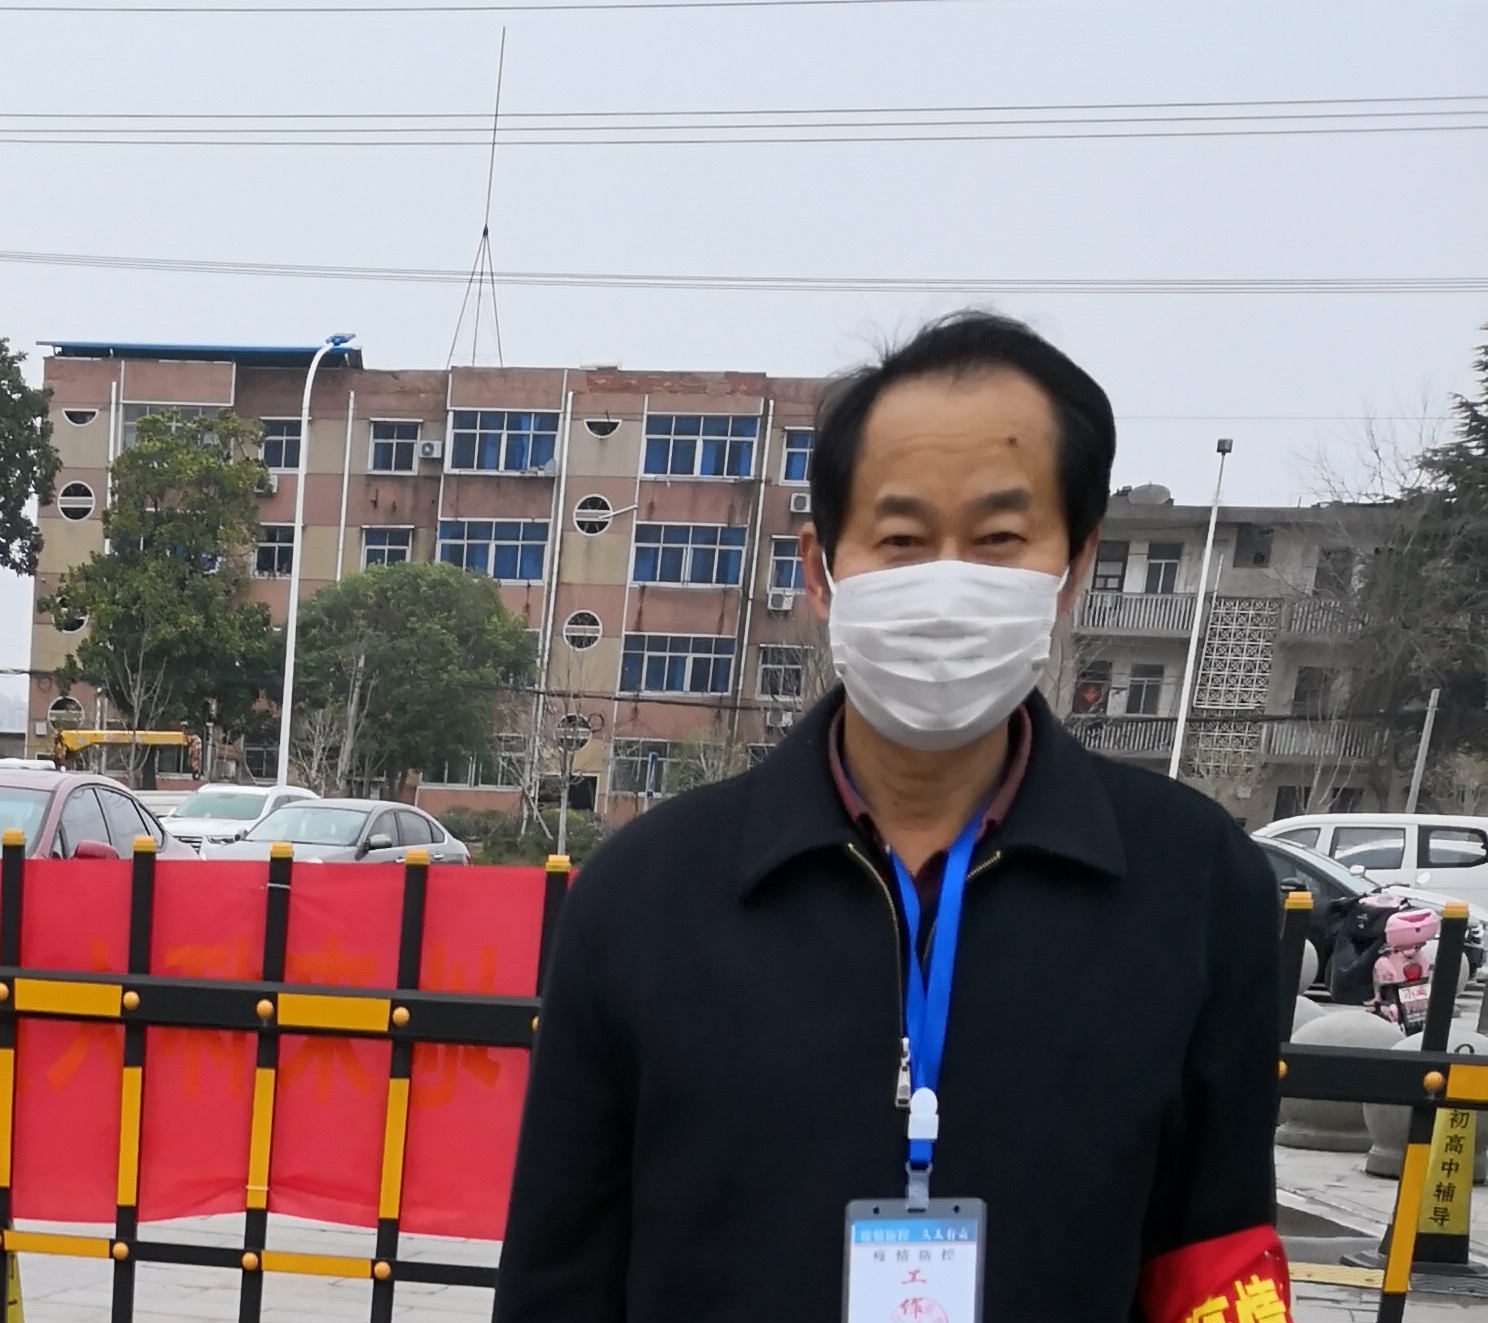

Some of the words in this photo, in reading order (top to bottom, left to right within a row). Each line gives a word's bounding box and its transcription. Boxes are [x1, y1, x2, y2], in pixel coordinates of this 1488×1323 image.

[1429, 1109, 1470, 1227] 初高中辅导
